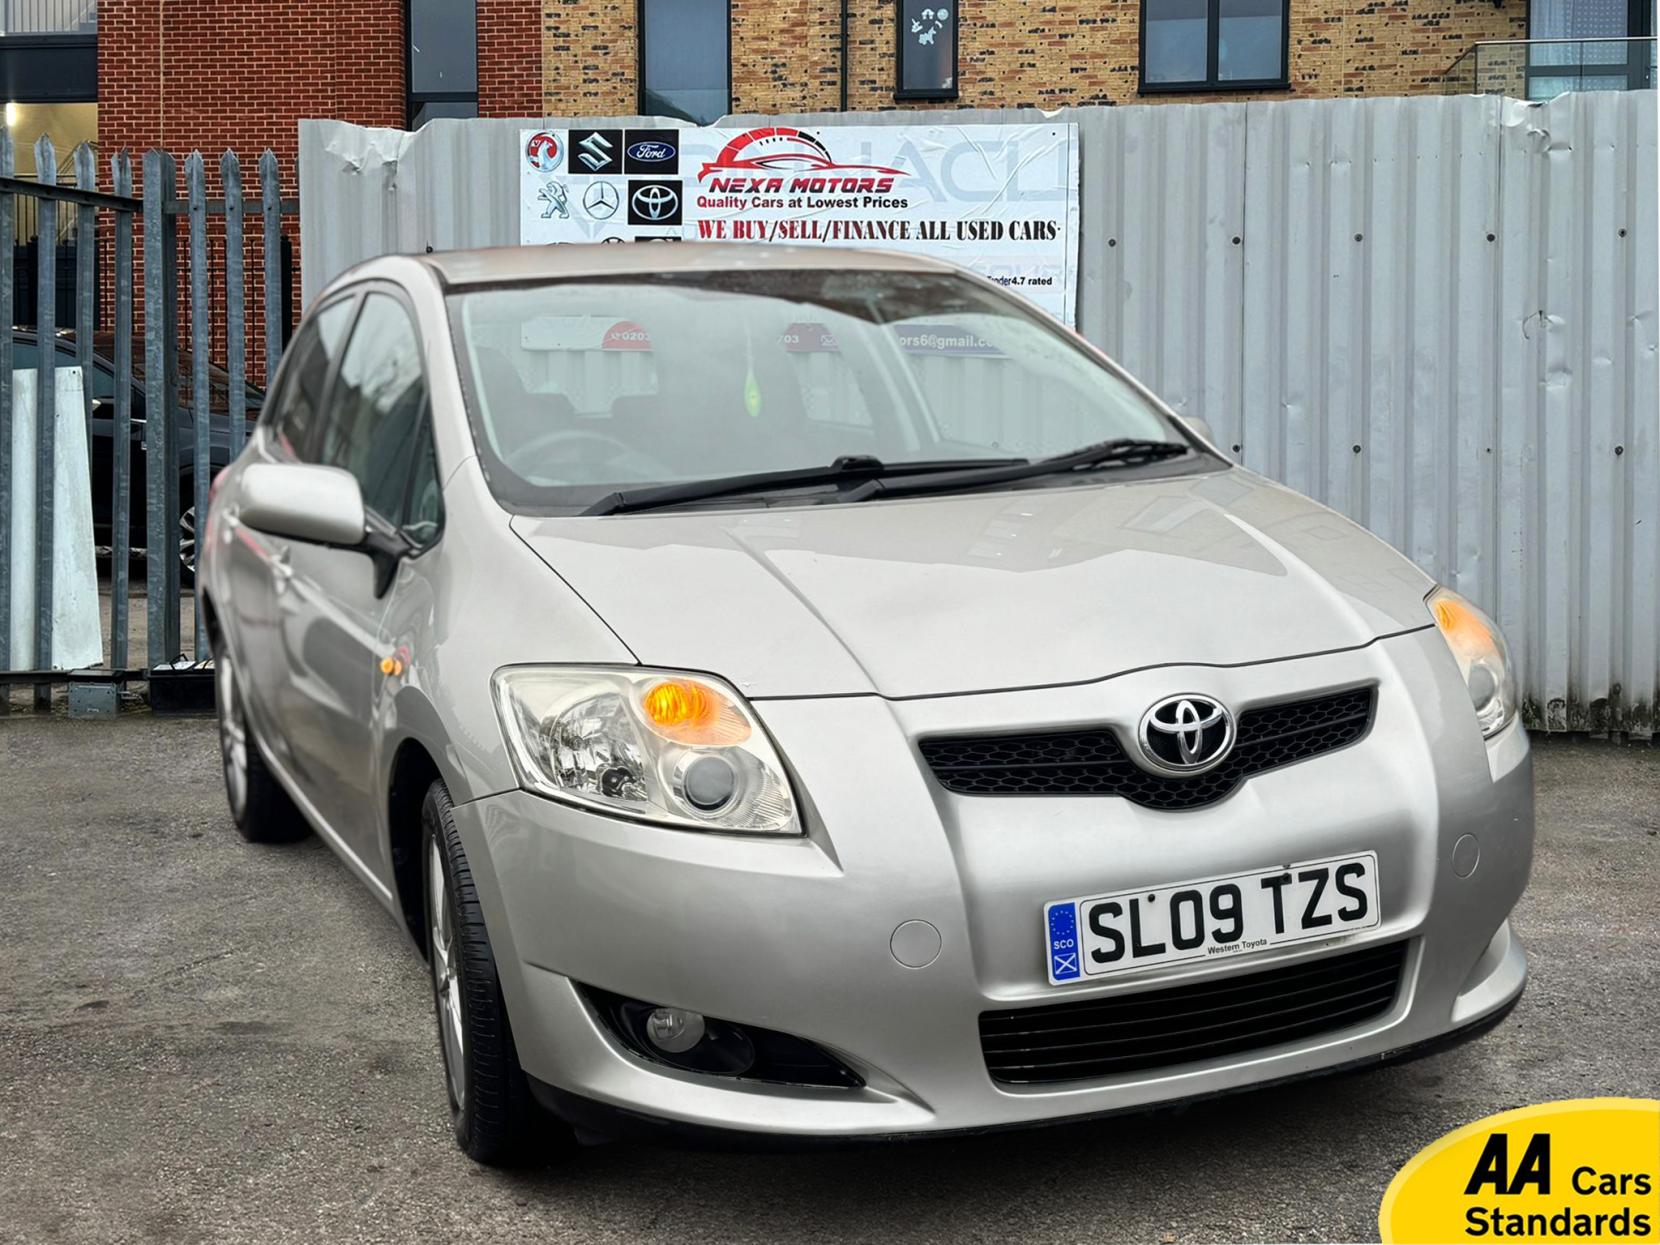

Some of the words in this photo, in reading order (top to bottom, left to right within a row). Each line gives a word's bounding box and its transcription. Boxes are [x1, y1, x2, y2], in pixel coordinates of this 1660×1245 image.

[635, 144, 667, 160] Ford
[709, 177, 784, 194] NEXA
[788, 177, 895, 194] MOTORS
[697, 195, 747, 211] Quality
[751, 196, 784, 209] Cars
[788, 197, 803, 208] at
[807, 196, 859, 209] Lowest
[863, 196, 909, 209] Prices
[697, 219, 727, 239] WE
[915, 220, 951, 241] ALL
[956, 220, 1004, 241] USED
[1008, 220, 1057, 241] CARS
[1027, 276, 1053, 286] rated
[1088, 883, 1245, 965] SL09
[1260, 861, 1369, 935] TZS
[1053, 938, 1075, 950] SCO
[1207, 943, 1241, 956] Western
[1241, 938, 1268, 950] Toyota
